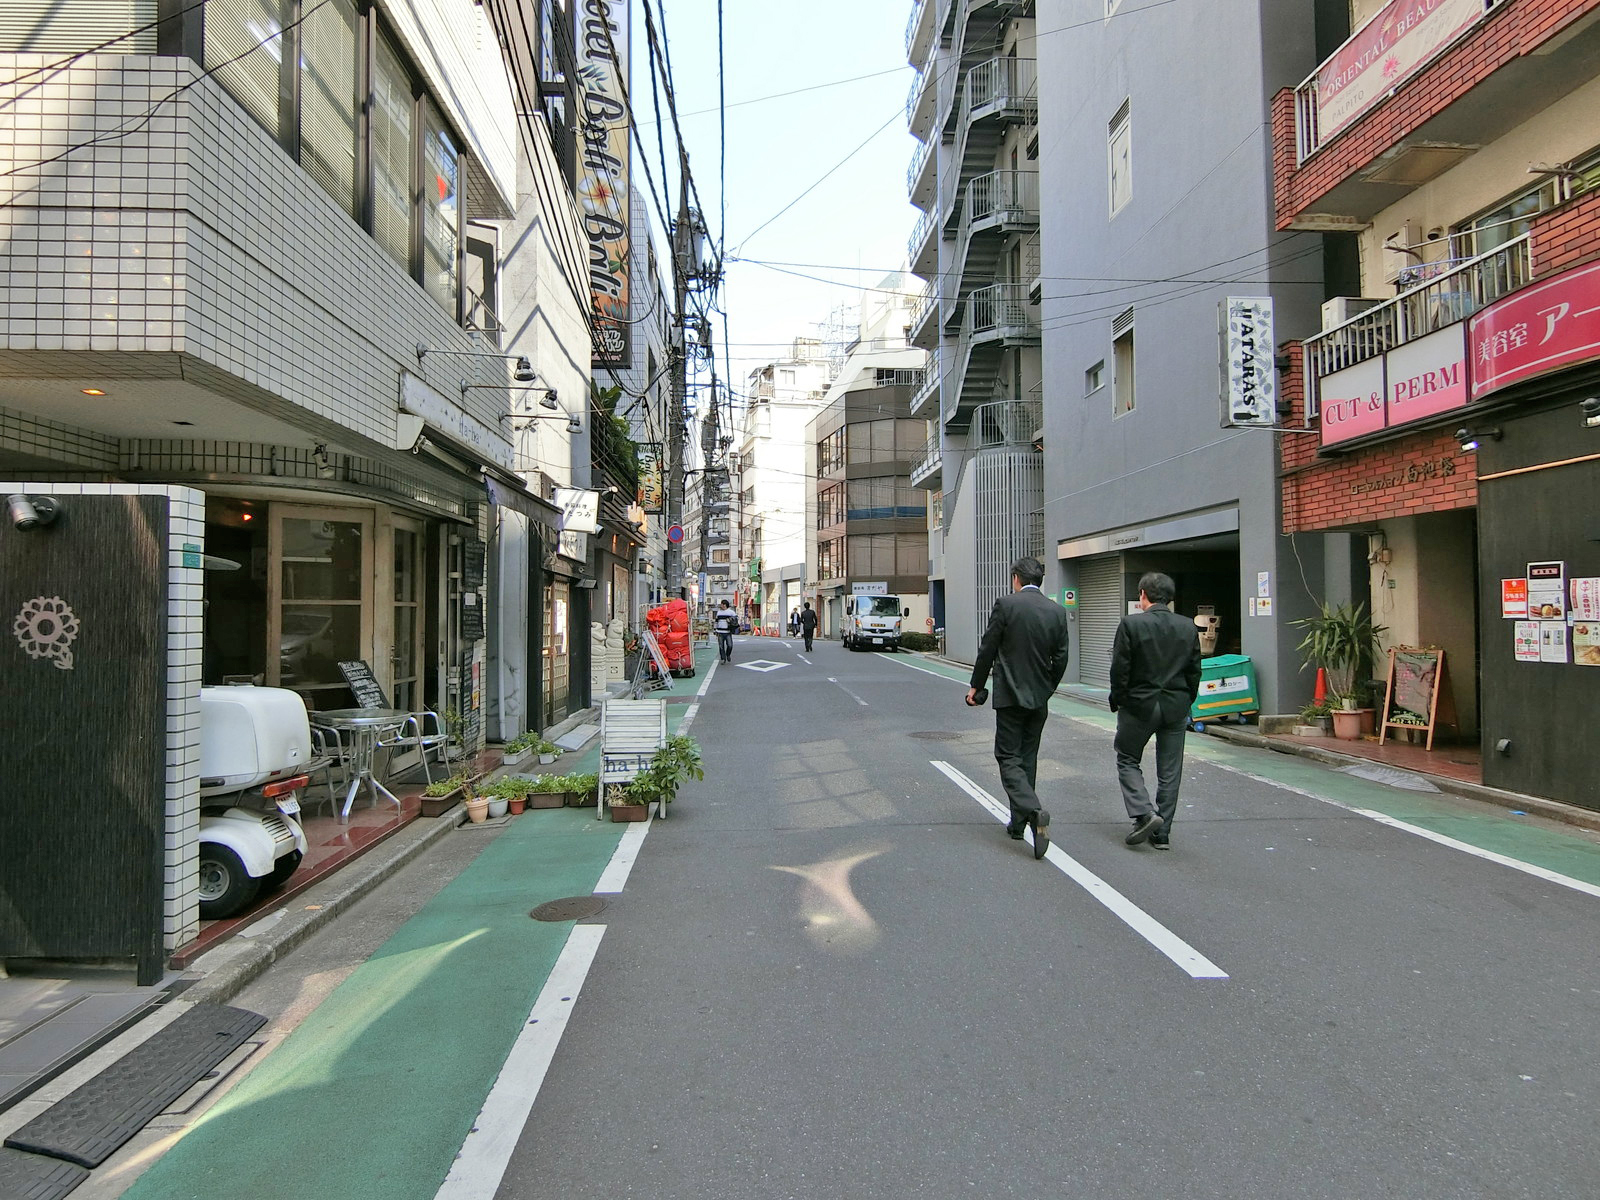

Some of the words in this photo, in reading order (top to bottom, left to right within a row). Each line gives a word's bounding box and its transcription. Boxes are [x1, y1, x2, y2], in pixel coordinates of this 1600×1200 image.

[586, 0, 620, 60] otel
[1327, 38, 1388, 97] ORIENTAL
[584, 92, 624, 176] Bali
[1332, 90, 1365, 121] PALPITO
[585, 213, 624, 296] Bali
[1478, 322, 1528, 366] 美容室
[1325, 397, 1361, 425] CUT
[1368, 391, 1381, 411] &
[1394, 362, 1459, 404] PERM
[604, 754, 655, 773] ha-h
